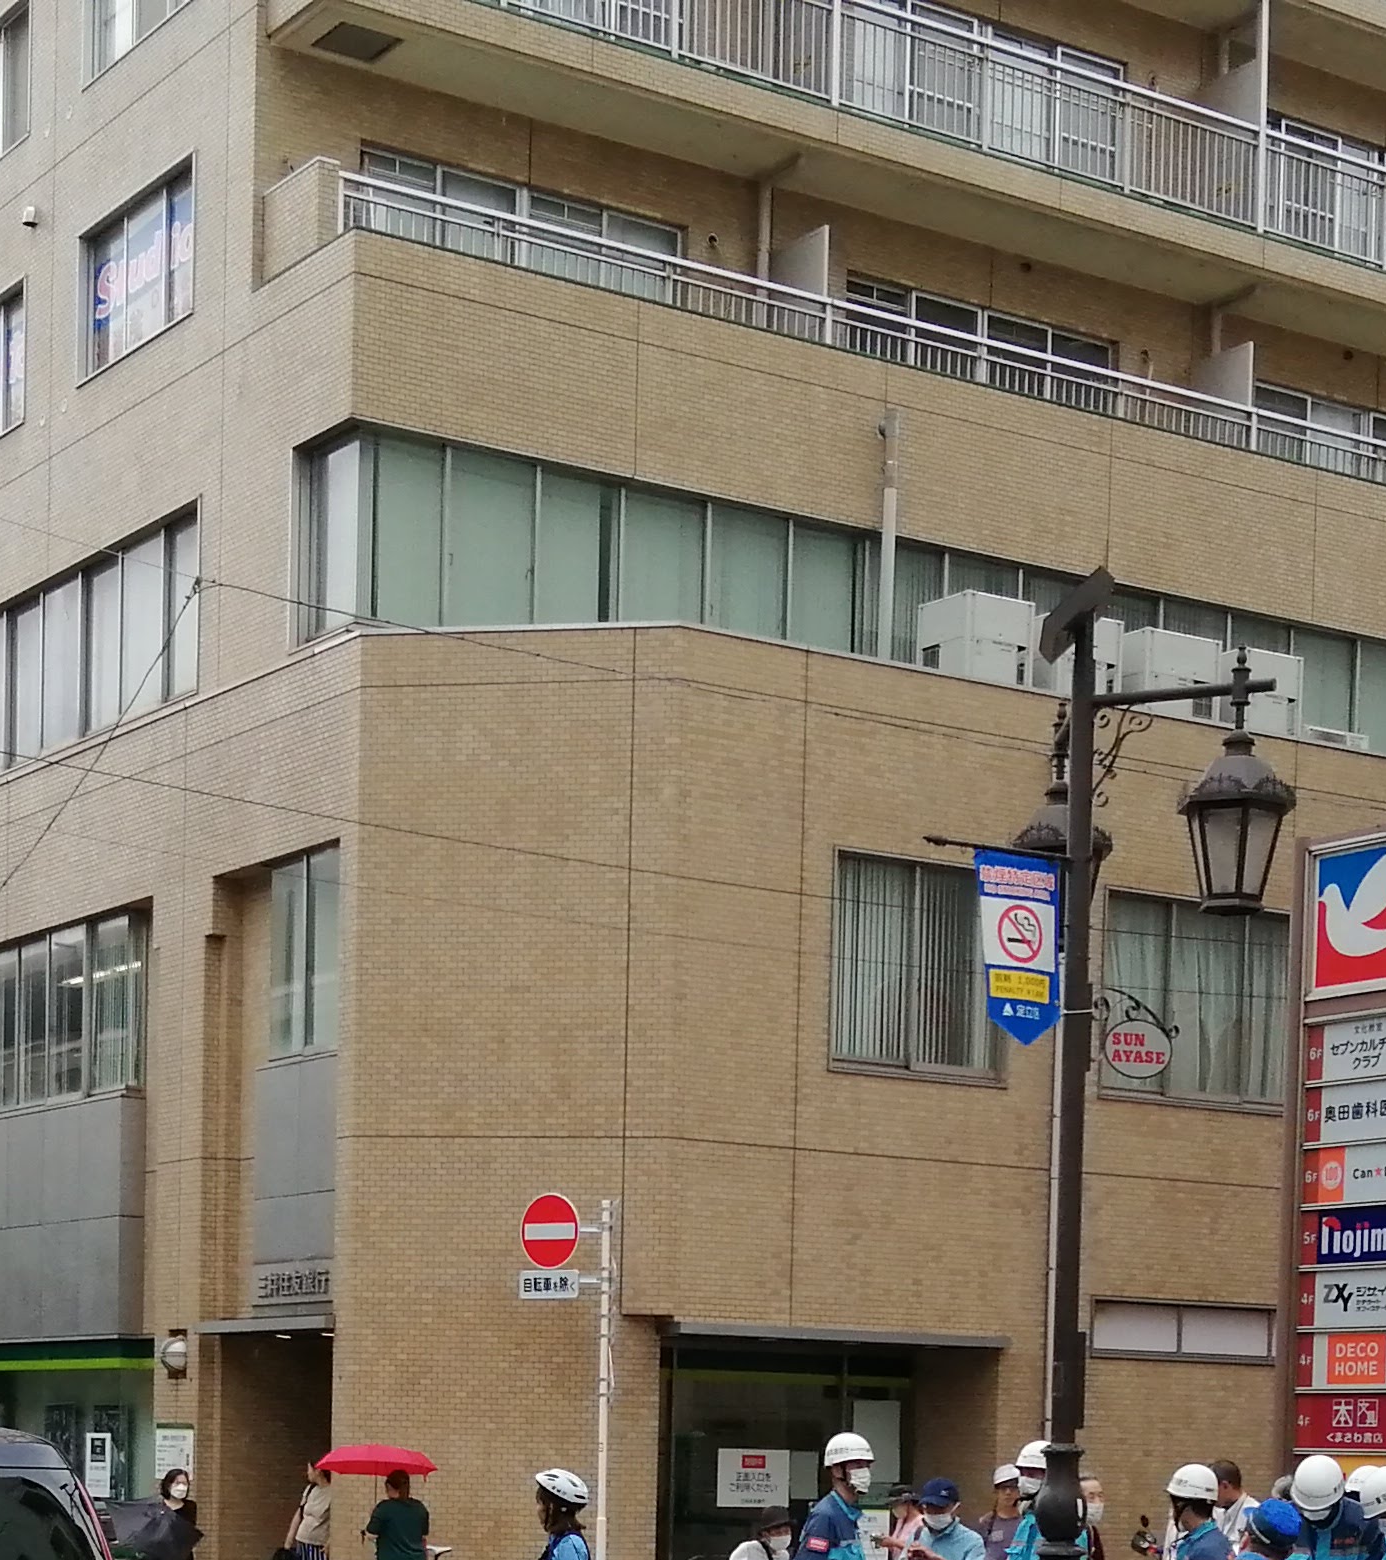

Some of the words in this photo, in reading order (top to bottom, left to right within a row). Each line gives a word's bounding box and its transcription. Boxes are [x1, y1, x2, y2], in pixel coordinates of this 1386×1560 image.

[1111, 1032, 1145, 1047] SUN
[1111, 1049, 1165, 1065] AYASE
[1309, 1047, 1322, 1060] 6F
[1352, 1053, 1382, 1071] クラブ
[1307, 1109, 1320, 1122] 6F
[1304, 1170, 1318, 1183] 6F
[1303, 1232, 1317, 1244] 5F
[257, 1269, 330, 1299] 三井住友銀行
[523, 1277, 576, 1293] 自転車を除く
[1300, 1293, 1314, 1305] 4F
[1323, 1283, 1353, 1312] ZXY
[1335, 1342, 1379, 1358] DECO
[1299, 1354, 1312, 1366] 4F
[1335, 1361, 1379, 1376] HOME
[1297, 1414, 1310, 1427] 4F
[1326, 1432, 1384, 1444] くまさわ書店
